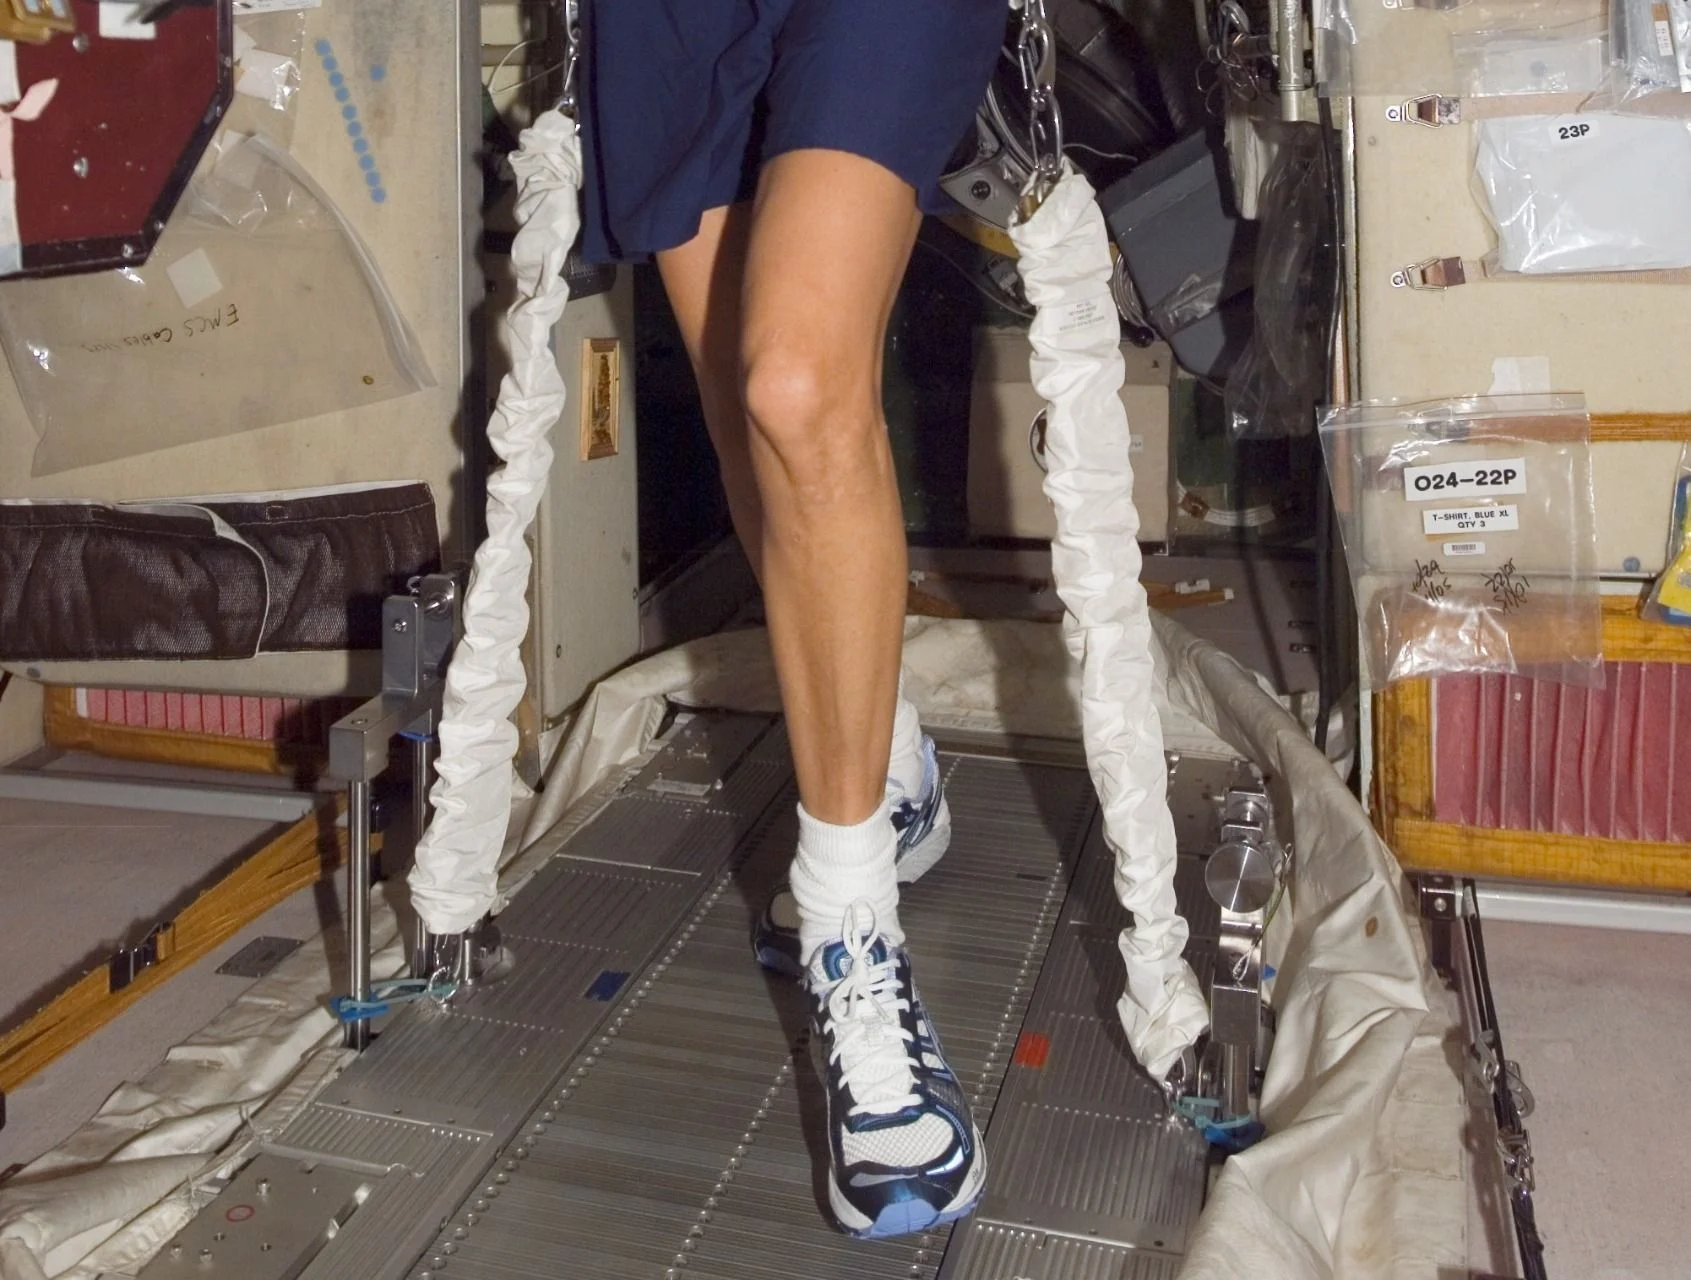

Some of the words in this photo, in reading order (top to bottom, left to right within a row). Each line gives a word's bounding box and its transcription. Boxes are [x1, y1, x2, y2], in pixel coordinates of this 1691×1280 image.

[1558, 124, 1590, 140] 23P
[1474, 510, 1495, 519] BLUE
[1499, 509, 1509, 517] XL
[1457, 521, 1476, 529] QTY
[1480, 520, 1486, 528] 3
